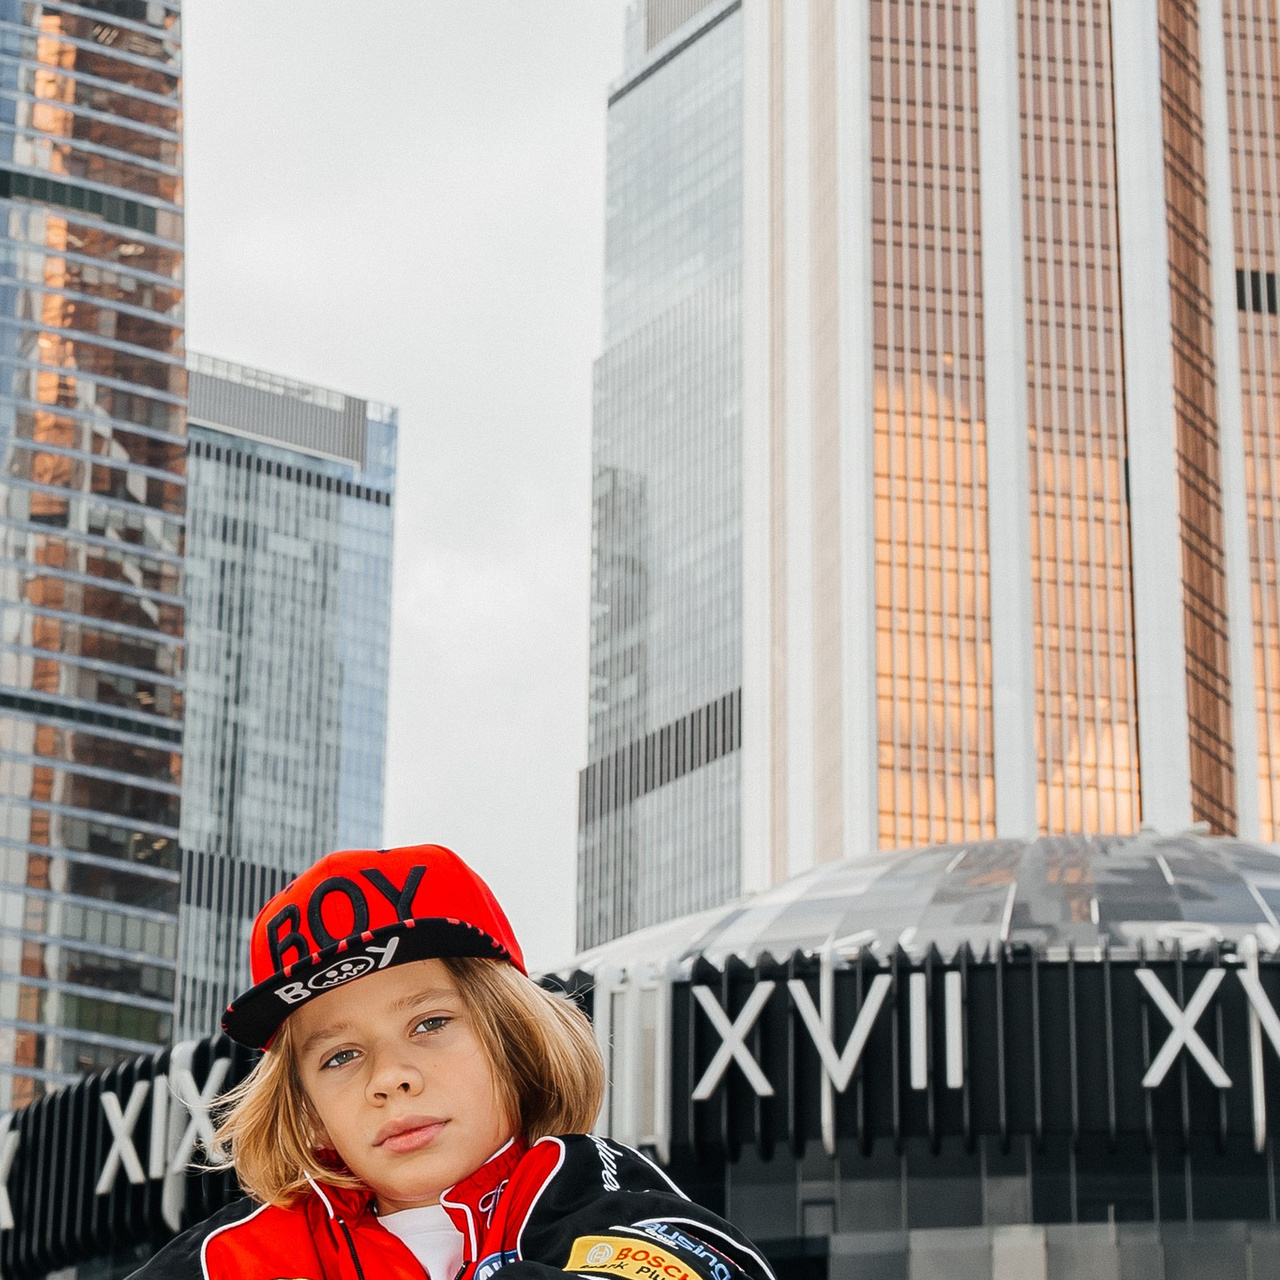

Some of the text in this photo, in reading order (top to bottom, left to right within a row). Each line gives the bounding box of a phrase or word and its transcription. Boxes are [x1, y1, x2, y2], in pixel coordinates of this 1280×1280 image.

[267, 865, 428, 974] BOY
[691, 970, 963, 1101] XVII
[95, 1057, 232, 1196] XIX
